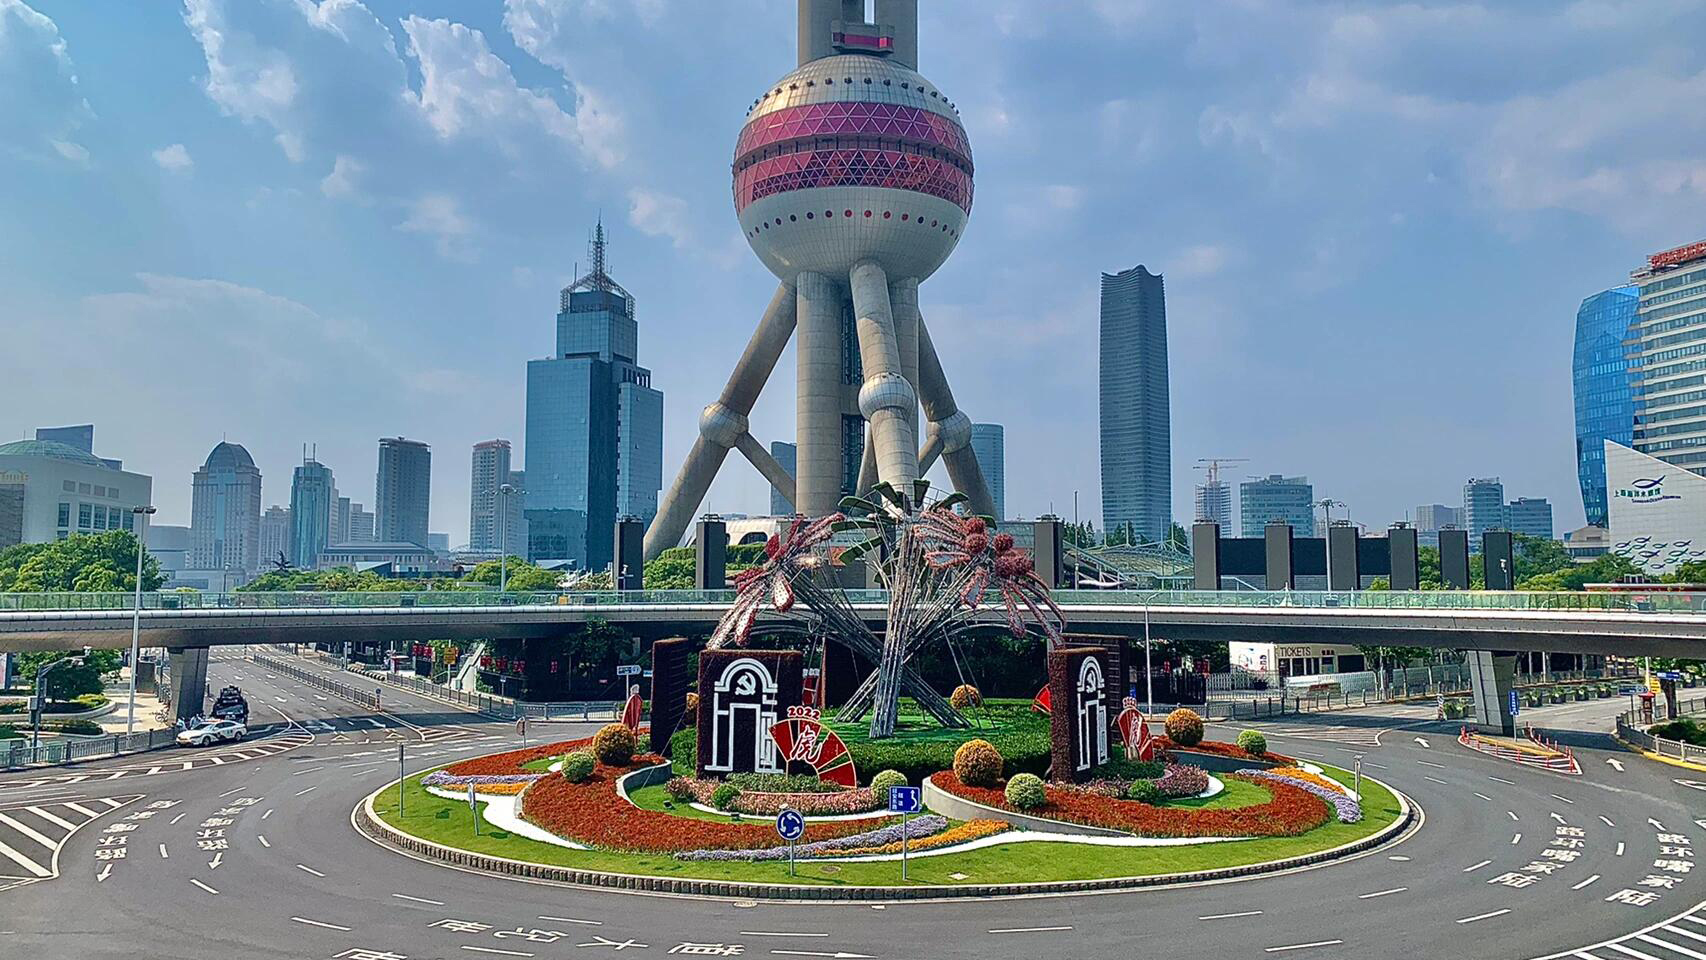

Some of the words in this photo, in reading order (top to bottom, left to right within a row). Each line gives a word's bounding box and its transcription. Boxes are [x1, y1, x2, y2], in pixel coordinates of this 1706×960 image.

[1280, 646, 1311, 656] TICKETS
[787, 706, 821, 720] 2022
[790, 724, 824, 764] 虎
[1605, 833, 1695, 907] 陆家嘴环路
